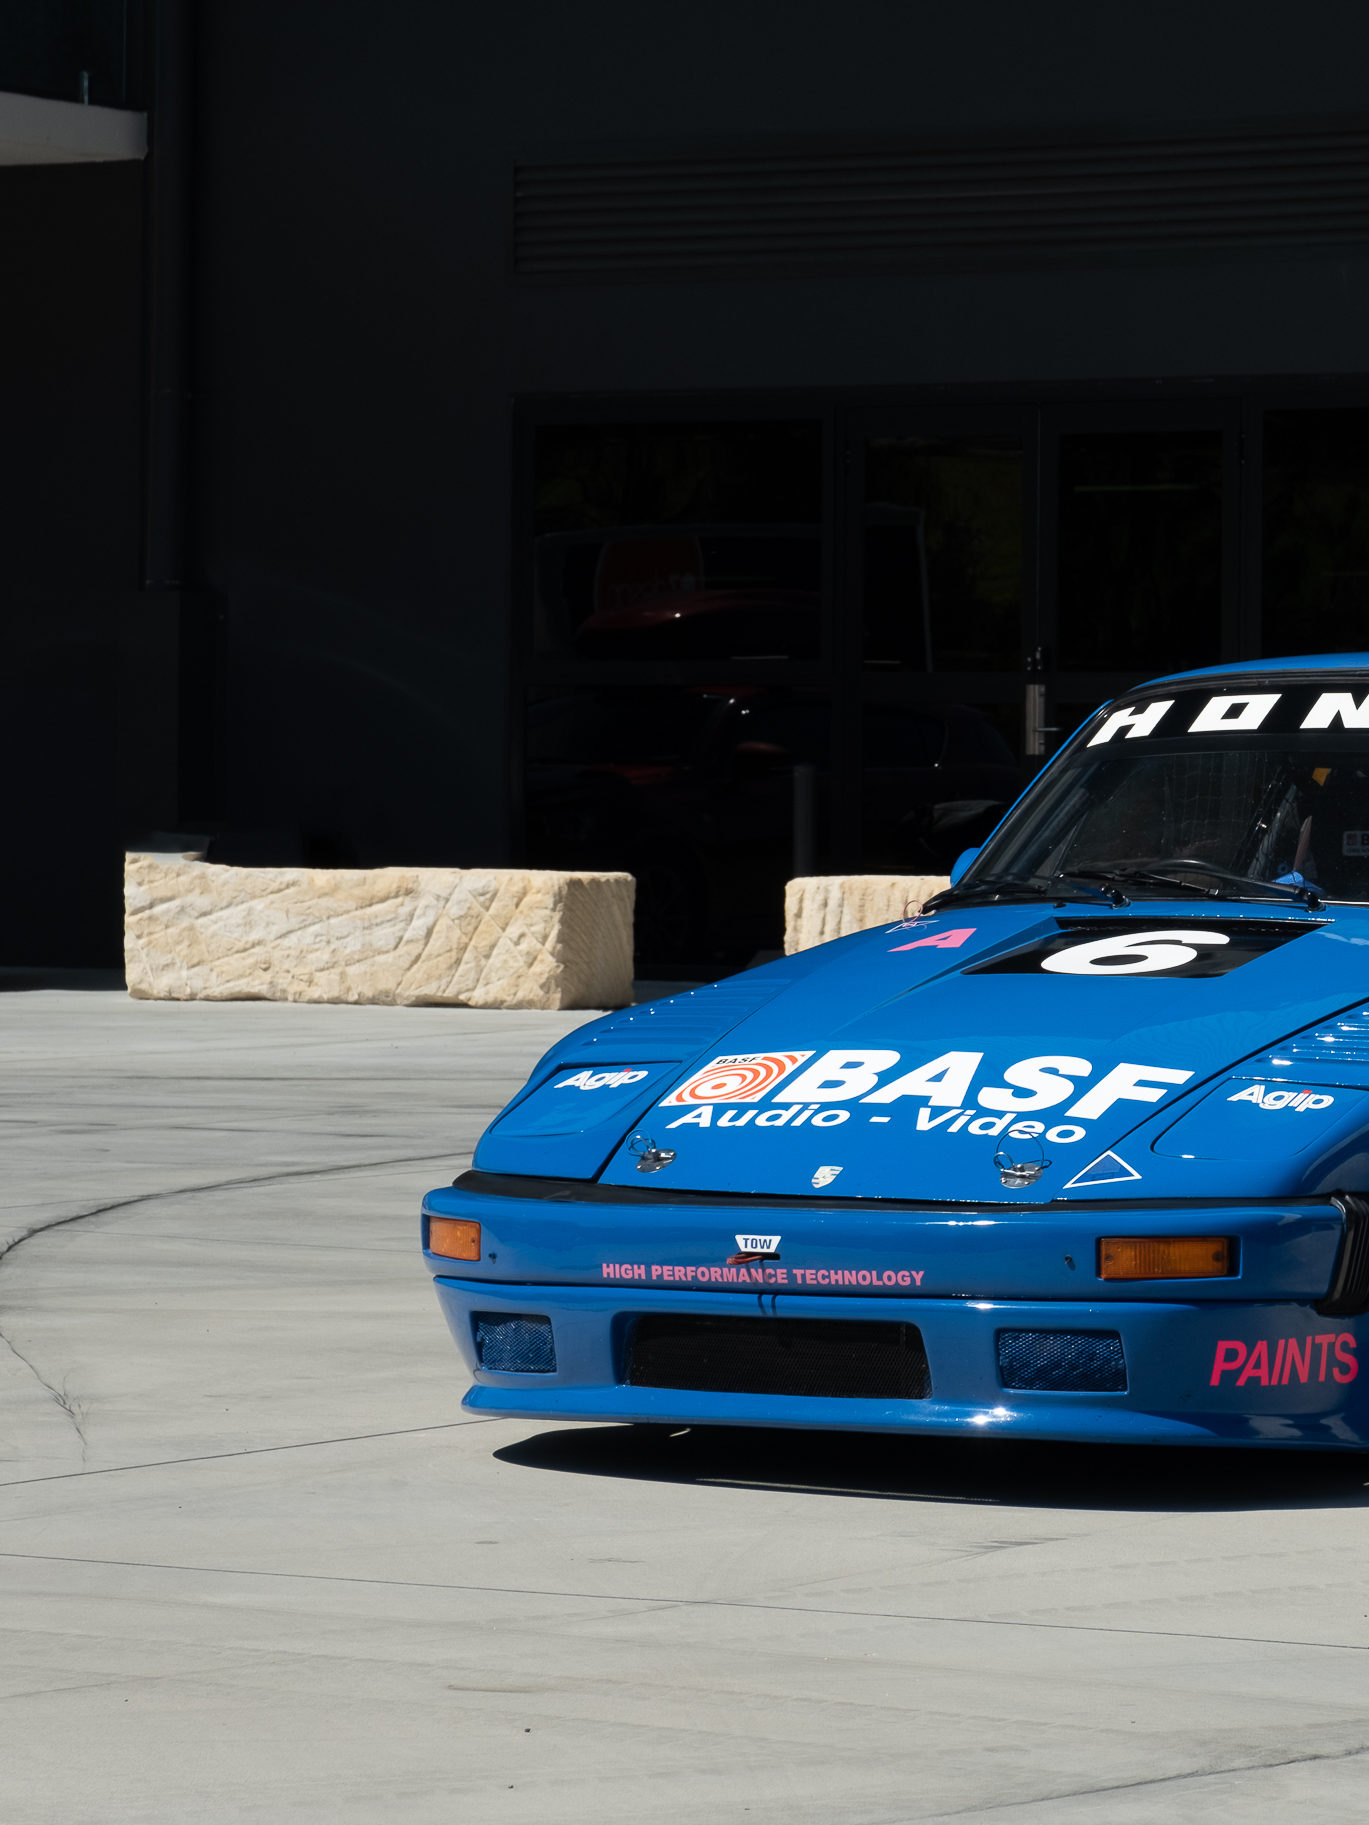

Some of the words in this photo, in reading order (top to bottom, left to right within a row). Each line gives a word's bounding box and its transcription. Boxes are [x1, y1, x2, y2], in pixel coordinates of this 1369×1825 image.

[1041, 930, 1230, 975] 6
[715, 1056, 762, 1065] BASF
[553, 1068, 649, 1091] Agip
[770, 1049, 1196, 1120] BASF
[1226, 1084, 1335, 1112] Agip
[665, 1104, 851, 1129] Audio
[915, 1107, 1086, 1144] Video
[742, 1237, 772, 1250] TOW
[602, 1263, 646, 1280] HIGH
[651, 1266, 788, 1284] PERFORMANCE
[793, 1269, 925, 1287] TECHNOLOGY
[1209, 1332, 1359, 1387] PAINTS
